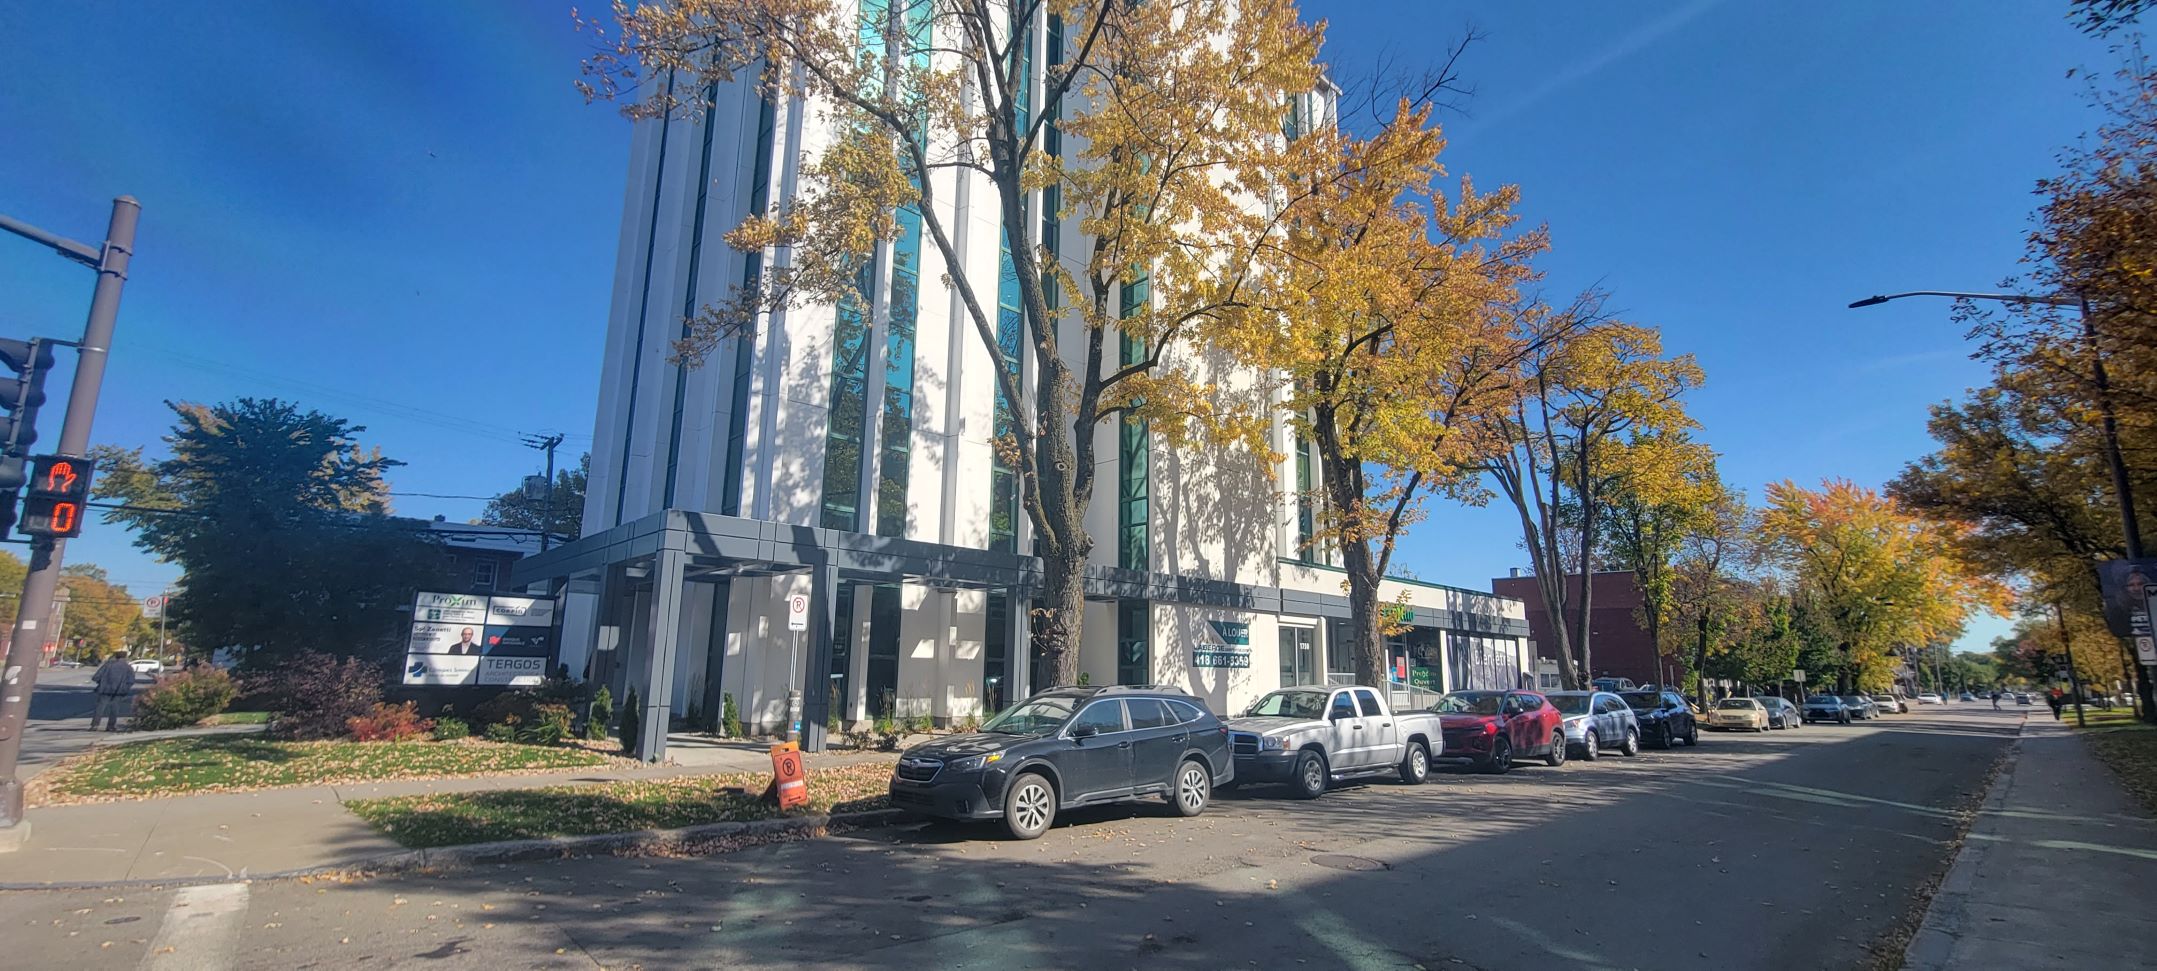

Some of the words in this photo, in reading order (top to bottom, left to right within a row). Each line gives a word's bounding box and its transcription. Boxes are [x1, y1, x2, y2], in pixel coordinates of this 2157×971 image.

[51, 503, 76, 532] 0
[487, 659, 541, 670] TERGOS
[1195, 654, 1210, 666] 418
